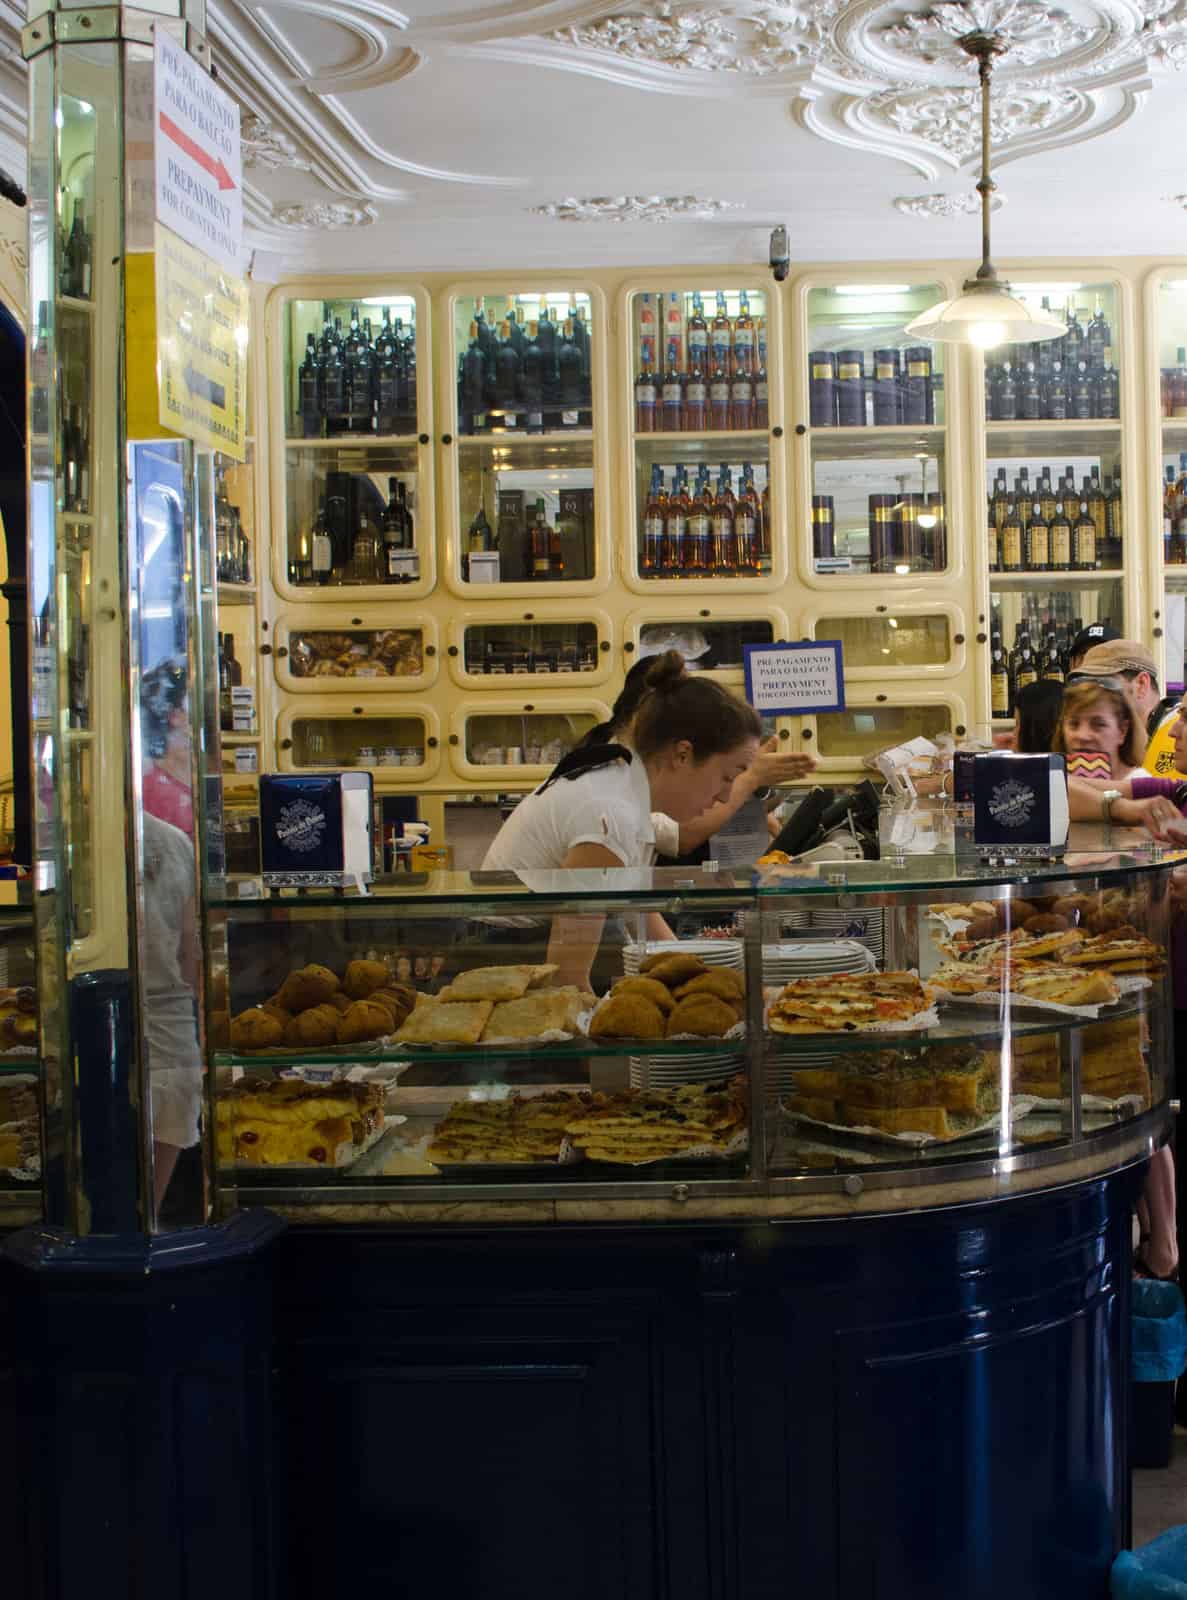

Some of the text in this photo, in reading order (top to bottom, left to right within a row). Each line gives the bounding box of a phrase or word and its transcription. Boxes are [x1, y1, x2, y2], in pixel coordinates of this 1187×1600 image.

[167, 156, 230, 227] PREPAYMENT
[161, 184, 178, 212] FOR
[760, 667, 782, 676] PARA
[784, 666, 790, 674] O
[762, 679, 825, 689] PREPAYMENT
[757, 688, 832, 700] FOR COUNTER ONLY
